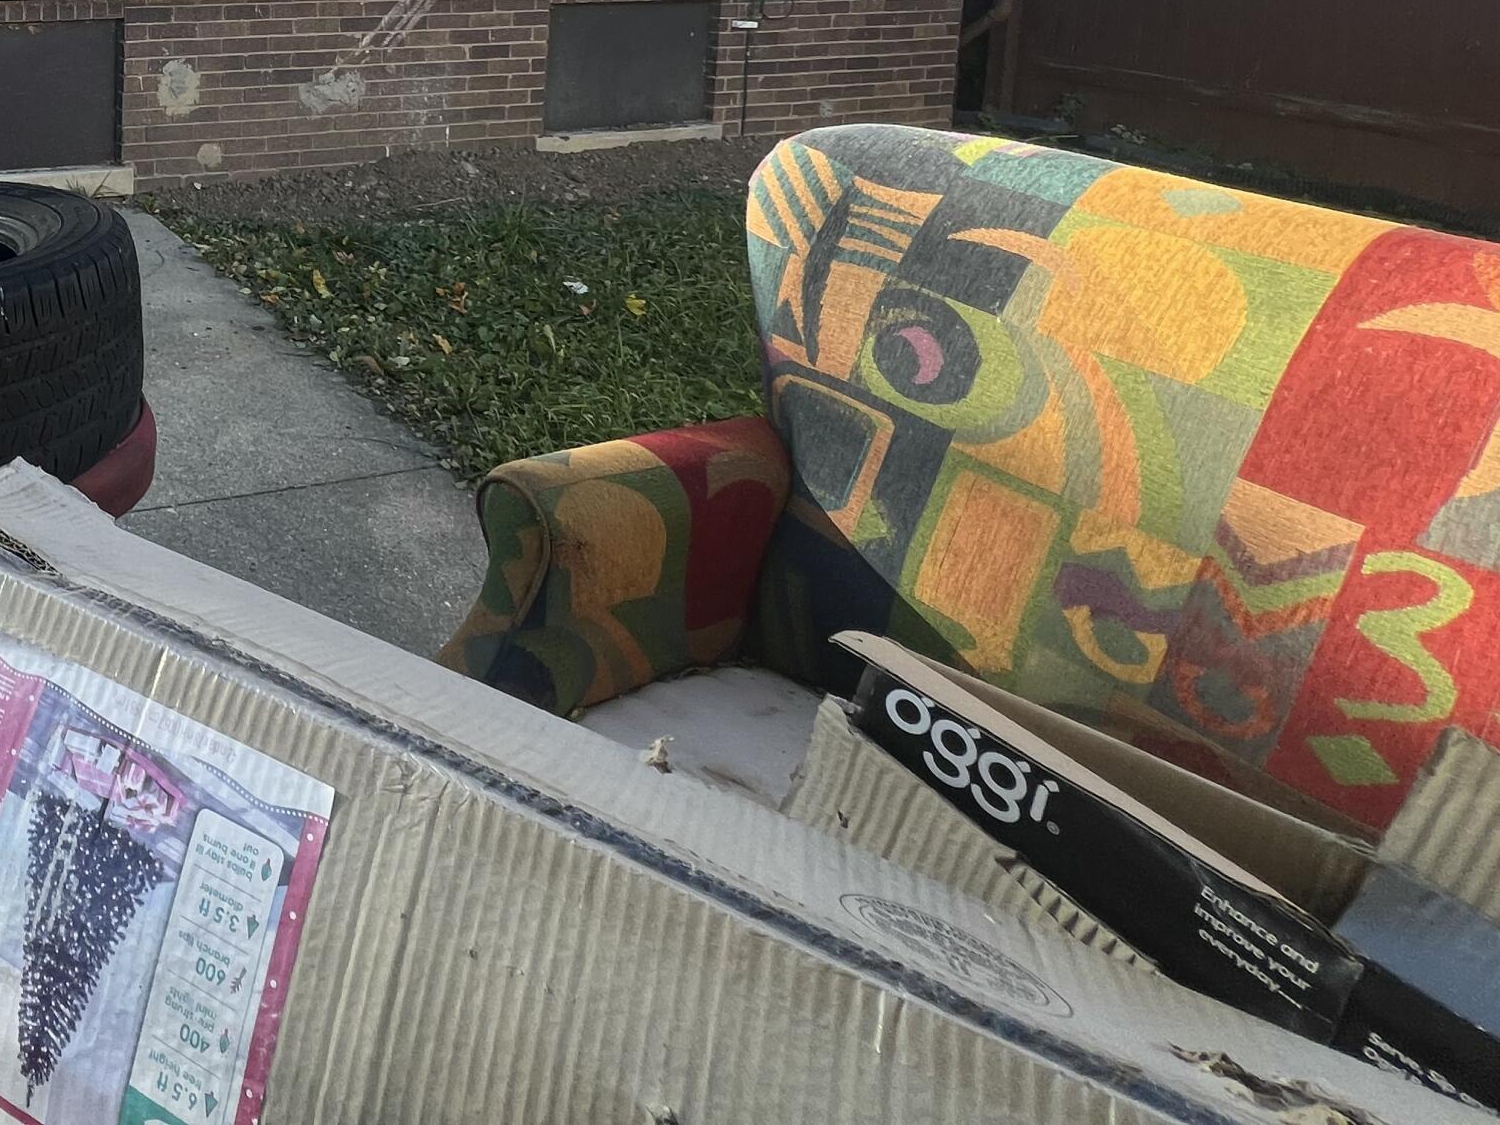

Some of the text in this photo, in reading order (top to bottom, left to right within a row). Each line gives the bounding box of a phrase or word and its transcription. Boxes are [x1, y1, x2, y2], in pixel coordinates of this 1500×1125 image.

[886, 689, 1060, 822] oggi
[204, 833, 228, 852] burns
[206, 849, 226, 866] stay
[230, 851, 249, 863] one
[242, 843, 259, 856] out
[226, 860, 252, 882] bulbs
[200, 882, 243, 912] diameter
[198, 897, 240, 932] 3.5 ft
[1202, 884, 1319, 973] Enhance and
[179, 930, 230, 967] branch tips
[1194, 902, 1312, 990] improve your
[196, 957, 226, 985] 600
[180, 1023, 210, 1053] 400
[149, 1049, 204, 1091] tree height
[156, 1071, 197, 1110] 6.5 ft
